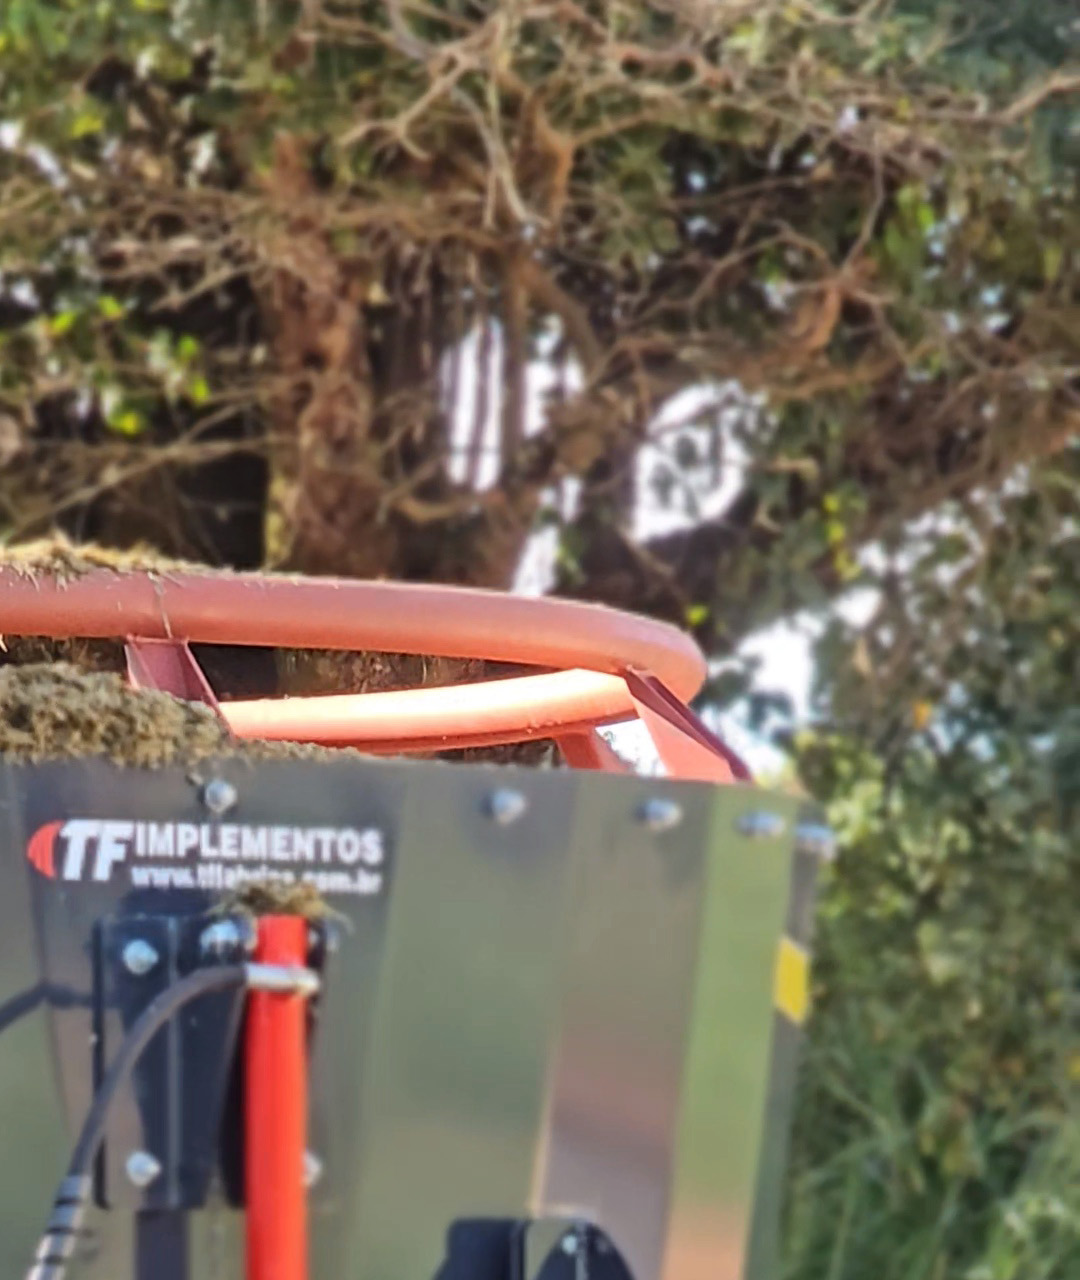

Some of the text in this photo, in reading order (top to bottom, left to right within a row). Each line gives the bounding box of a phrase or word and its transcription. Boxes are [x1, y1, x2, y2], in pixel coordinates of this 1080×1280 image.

[59, 819, 384, 881] TF IMPLEMENTOS
[131, 864, 384, 895] www.tffabricacom.br
